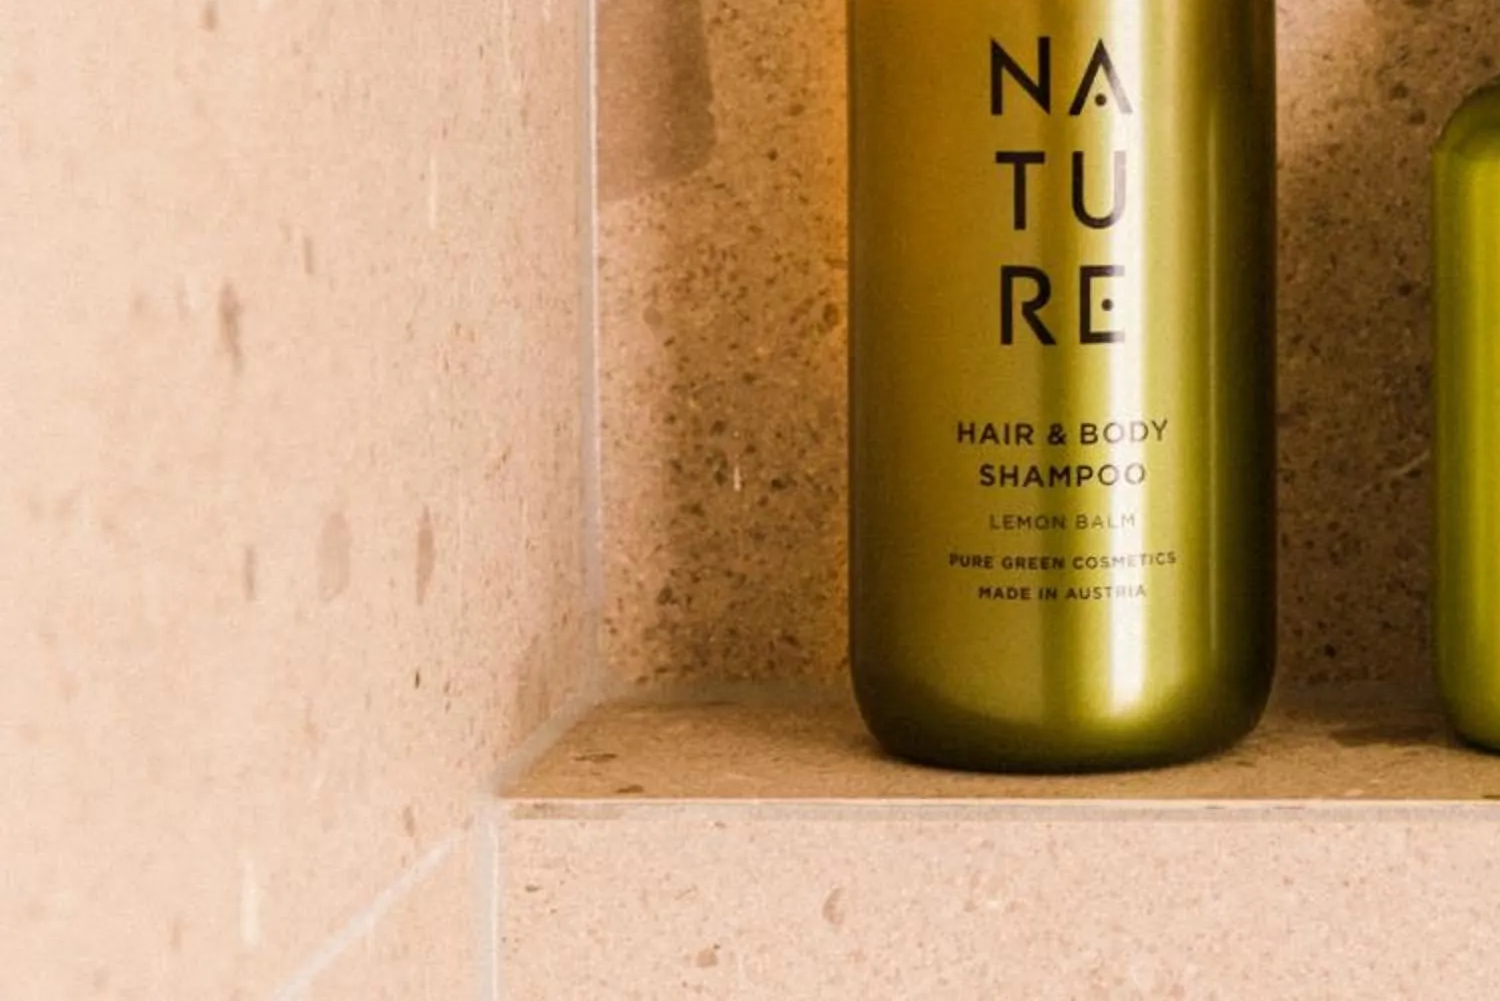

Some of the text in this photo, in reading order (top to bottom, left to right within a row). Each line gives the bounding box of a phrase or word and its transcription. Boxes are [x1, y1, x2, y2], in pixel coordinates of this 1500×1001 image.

[991, 36, 1133, 115] NA
[995, 151, 1126, 230] TU
[1001, 265, 1125, 345] RE
[957, 419, 1168, 445] HAIR & BODY
[979, 463, 1146, 487] SHAMPOO
[989, 513, 1136, 530] LEMON BALM
[949, 552, 1177, 570] PURE GREEN COSMETICS
[978, 585, 1147, 600] MADE IN AUSTRIA
